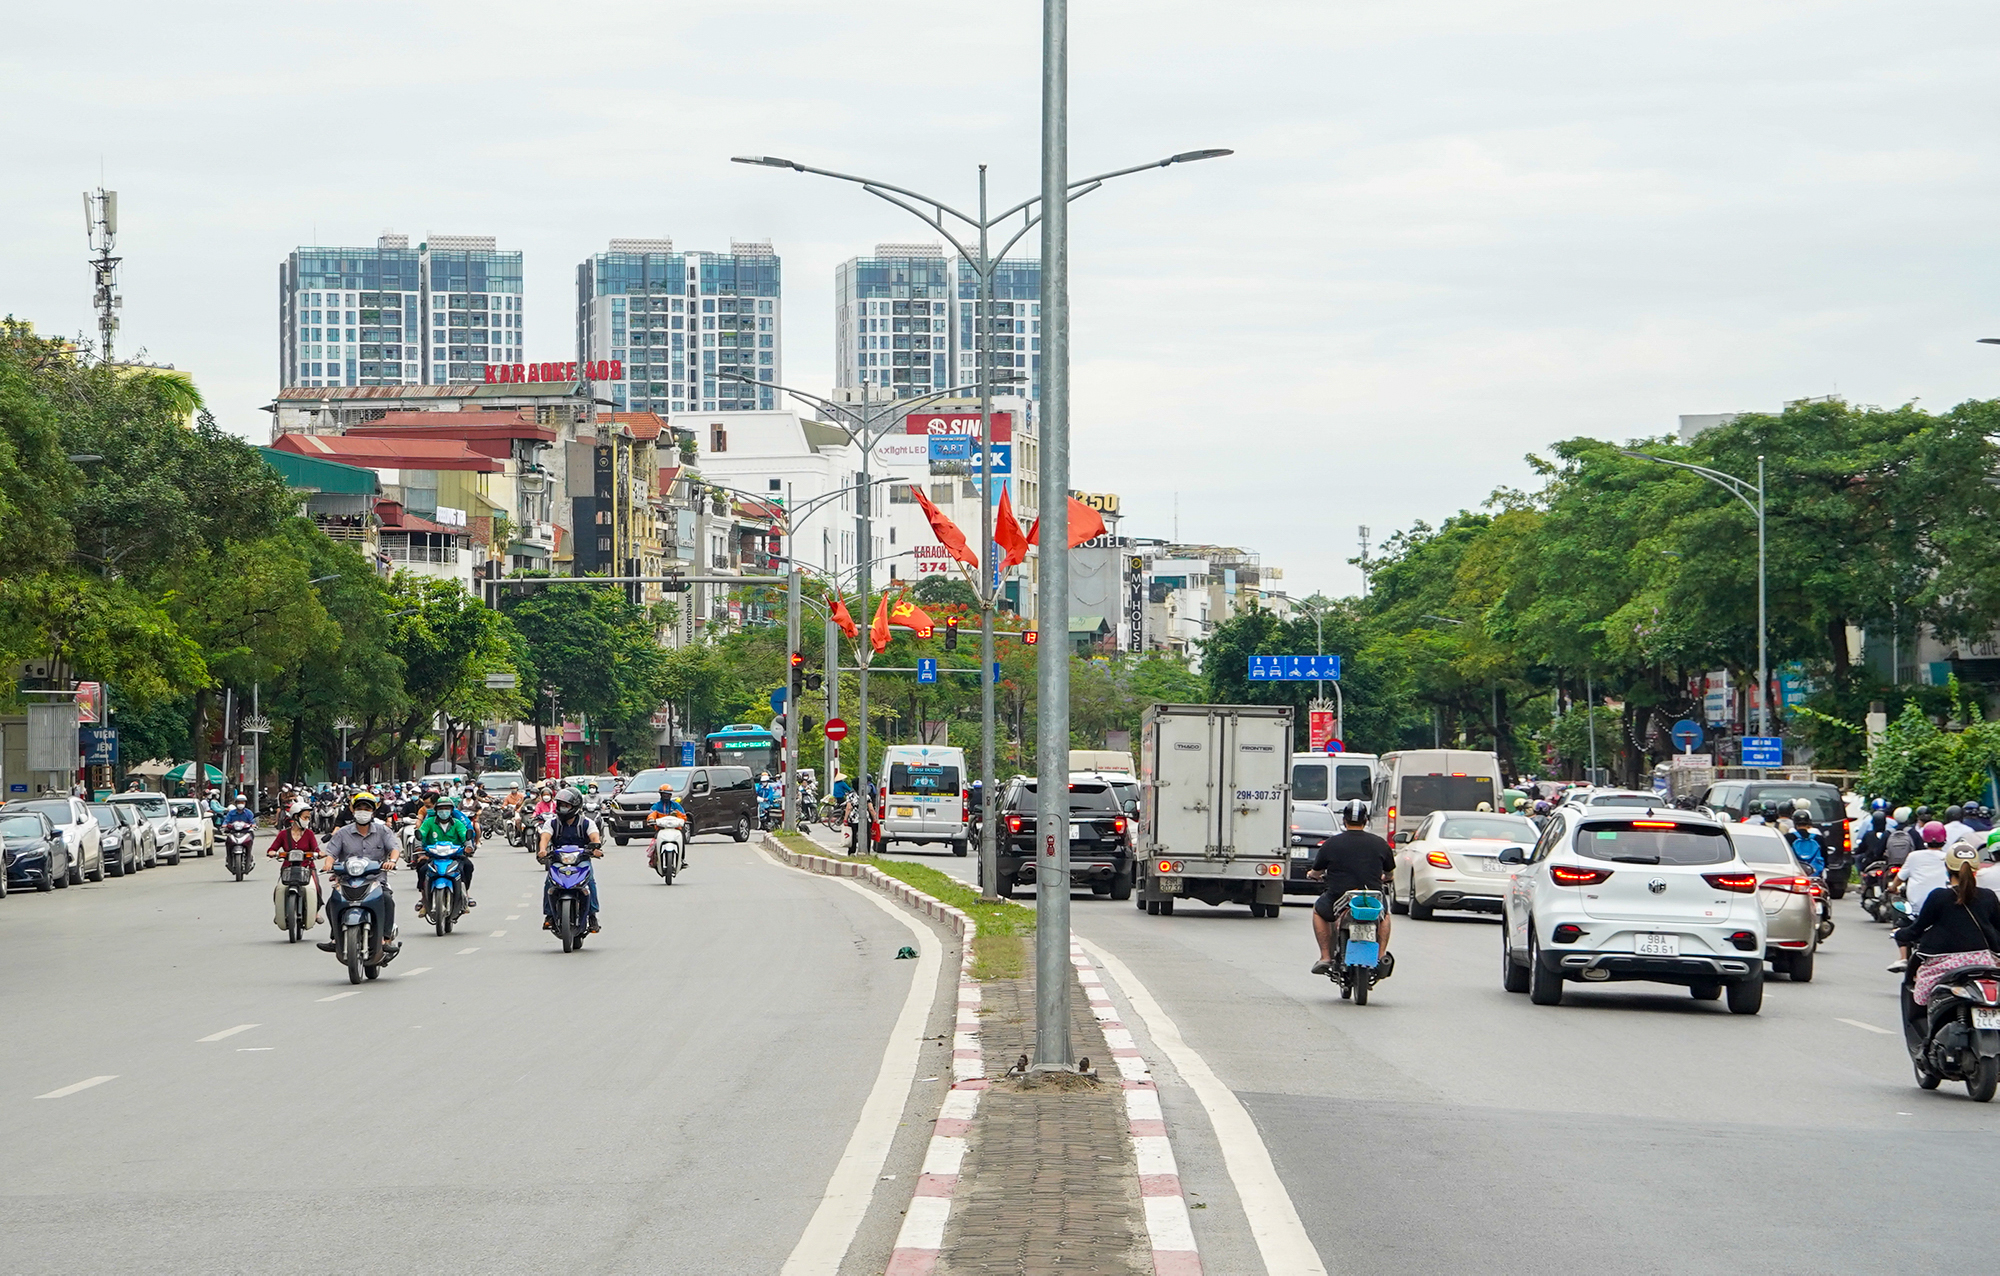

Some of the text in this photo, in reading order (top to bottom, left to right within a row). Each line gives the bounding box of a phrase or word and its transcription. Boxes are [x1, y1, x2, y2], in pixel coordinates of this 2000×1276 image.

[485, 360, 622, 384] KARAOKE 408
[949, 418, 982, 438] SIN
[909, 446, 927, 454] LED
[920, 562, 947, 573] 374
[1131, 573, 1142, 652] MY HOUSE
[1027, 632, 1037, 644] 13
[1236, 790, 1282, 800] 29H-307.37
[1647, 935, 1667, 944] 98A
[1640, 945, 1674, 954] 463.61
